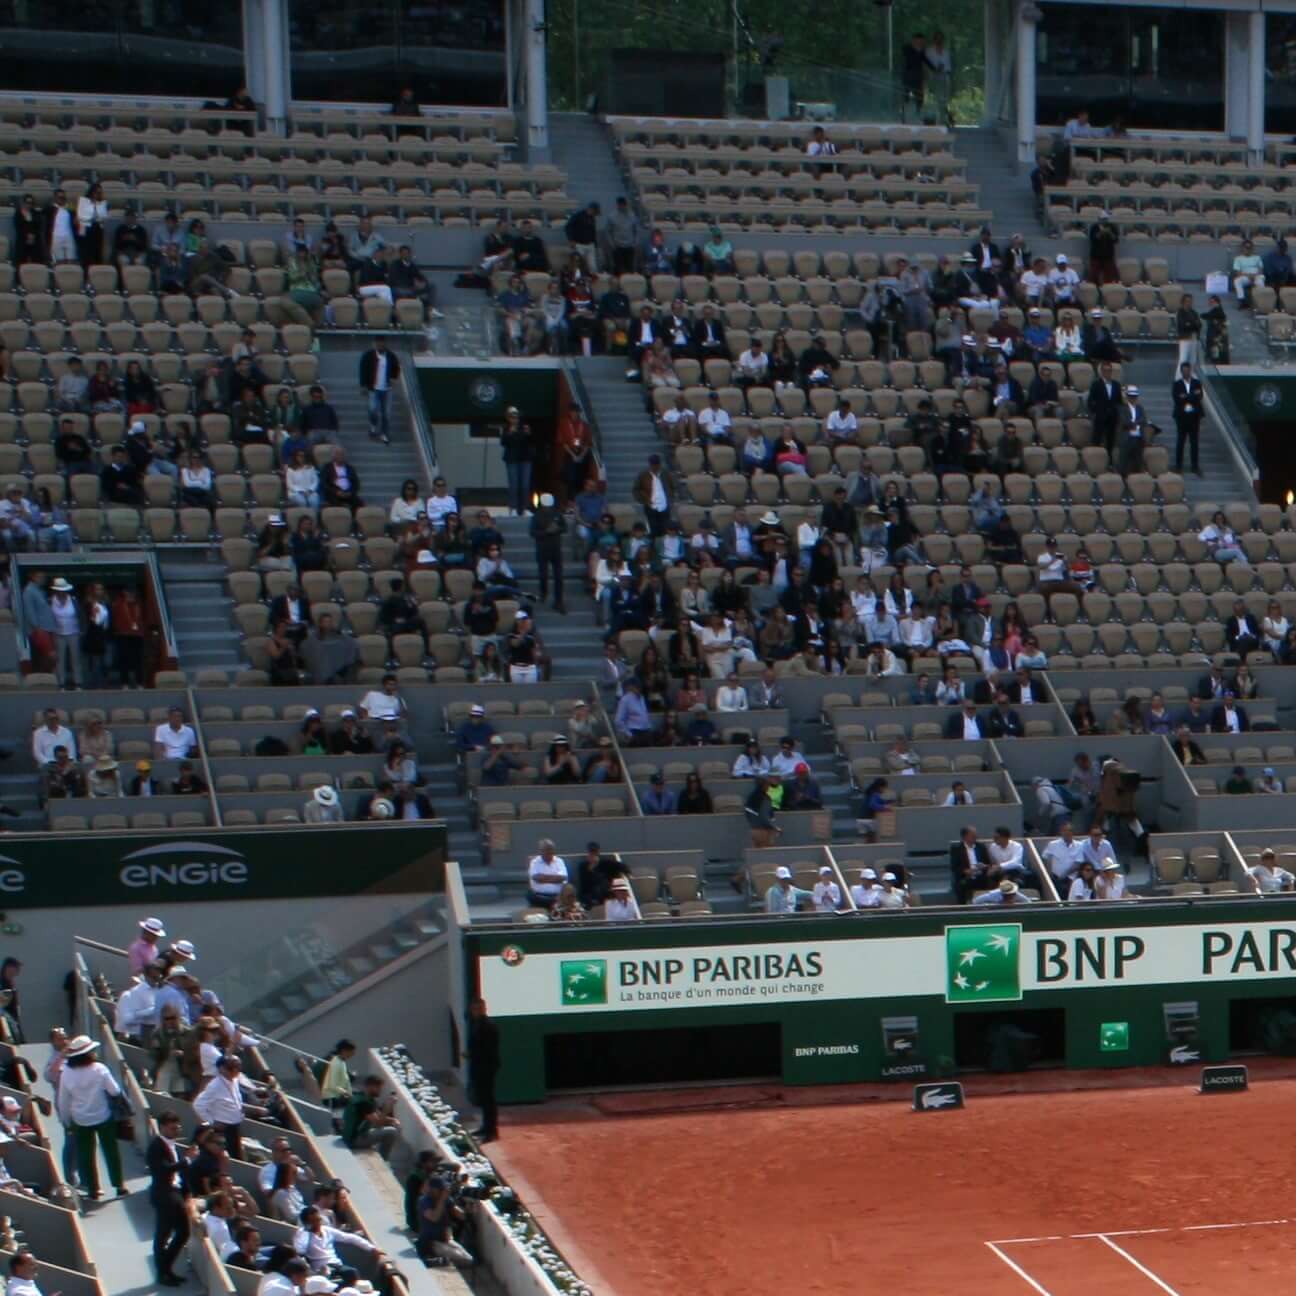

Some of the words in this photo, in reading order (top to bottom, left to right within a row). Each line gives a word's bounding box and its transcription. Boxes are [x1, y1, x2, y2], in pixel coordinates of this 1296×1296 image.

[1036, 936, 1145, 983] BNP
[619, 959, 683, 987] BNP
[692, 951, 823, 983] PARIBAS
[620, 991, 633, 1002] La
[638, 989, 681, 1002] banque
[686, 986, 712, 999] d'un
[716, 984, 756, 998] monde
[760, 982, 778, 998] qui
[782, 981, 825, 996] change
[795, 1048, 817, 1057] BNP
[818, 1044, 859, 1056] PARIBAS
[882, 1064, 926, 1076] LACOSTE
[1204, 1075, 1244, 1085] LACOSTE
